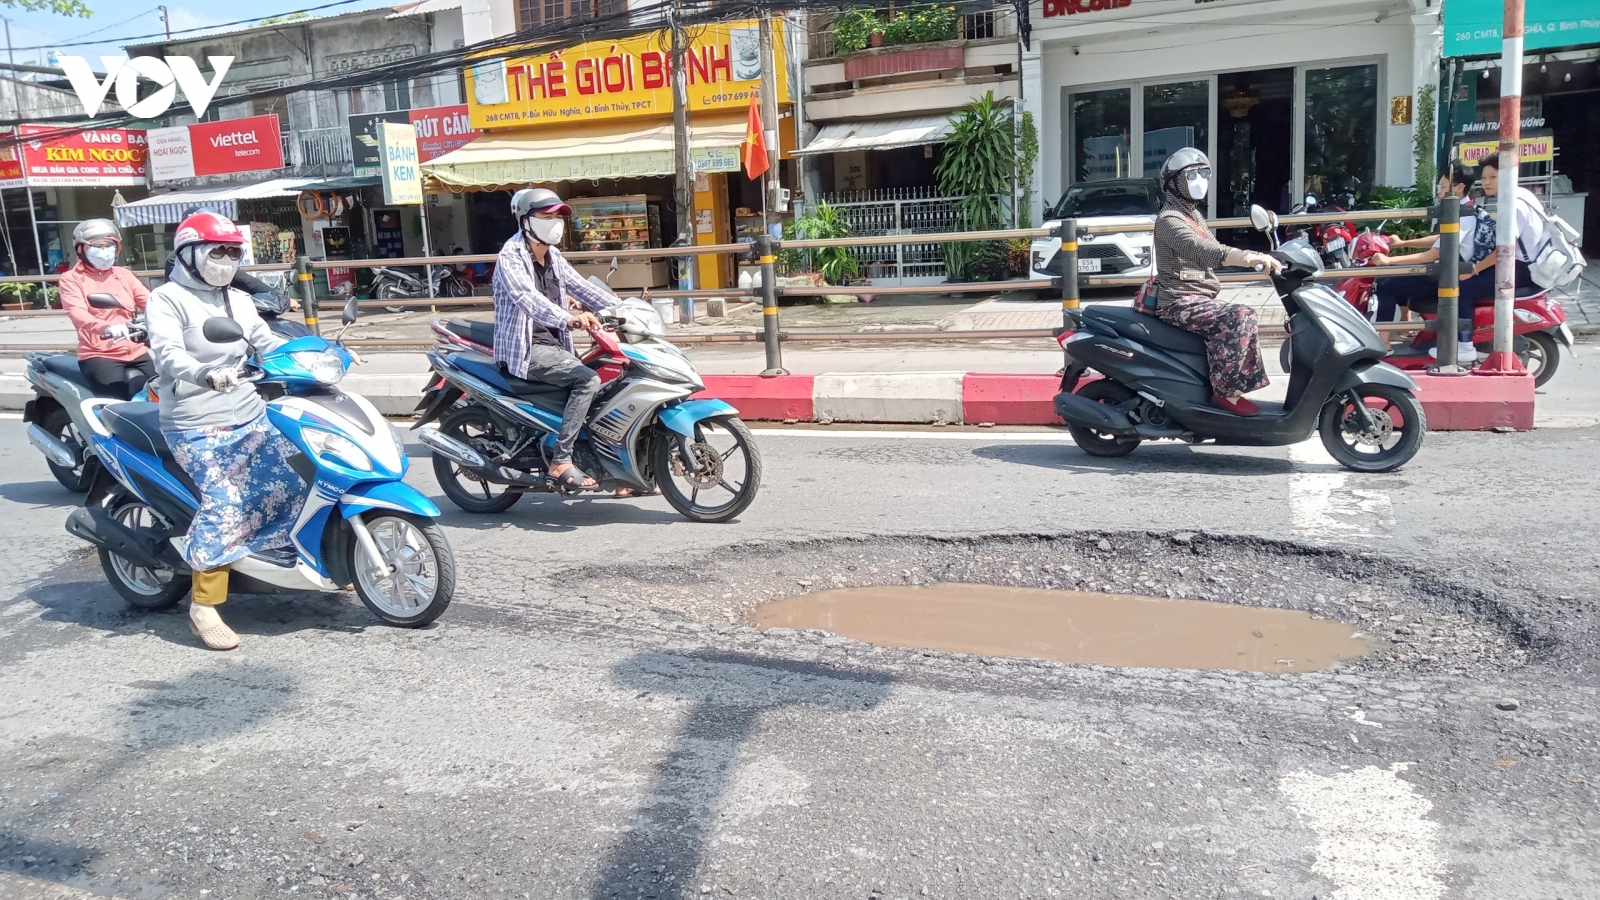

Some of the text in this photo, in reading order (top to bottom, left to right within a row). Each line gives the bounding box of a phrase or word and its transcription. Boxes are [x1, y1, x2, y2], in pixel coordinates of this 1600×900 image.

[1455, 31, 1470, 41] 260
[1473, 29, 1499, 38] CMT8,
[507, 48, 568, 101] THẾ
[575, 45, 635, 95] GIỚI
[712, 90, 761, 102] 0907 699 68
[486, 113, 499, 121] 268
[499, 111, 521, 120] CMT8,
[631, 100, 652, 110] TPCT
[413, 114, 439, 138] RÚT
[1462, 122, 1486, 132] BÁNH
[81, 130, 122, 144] VÀNG
[210, 130, 258, 148] viettel
[169, 145, 187, 156] NGỌC
[235, 148, 260, 157] telecom
[388, 142, 416, 162] BÁNH
[1519, 142, 1548, 157] IETNAM
[31, 166, 48, 174] MUA
[67, 166, 79, 174] GIA
[393, 165, 415, 181] KEM
[317, 479, 345, 494] KYMCO
